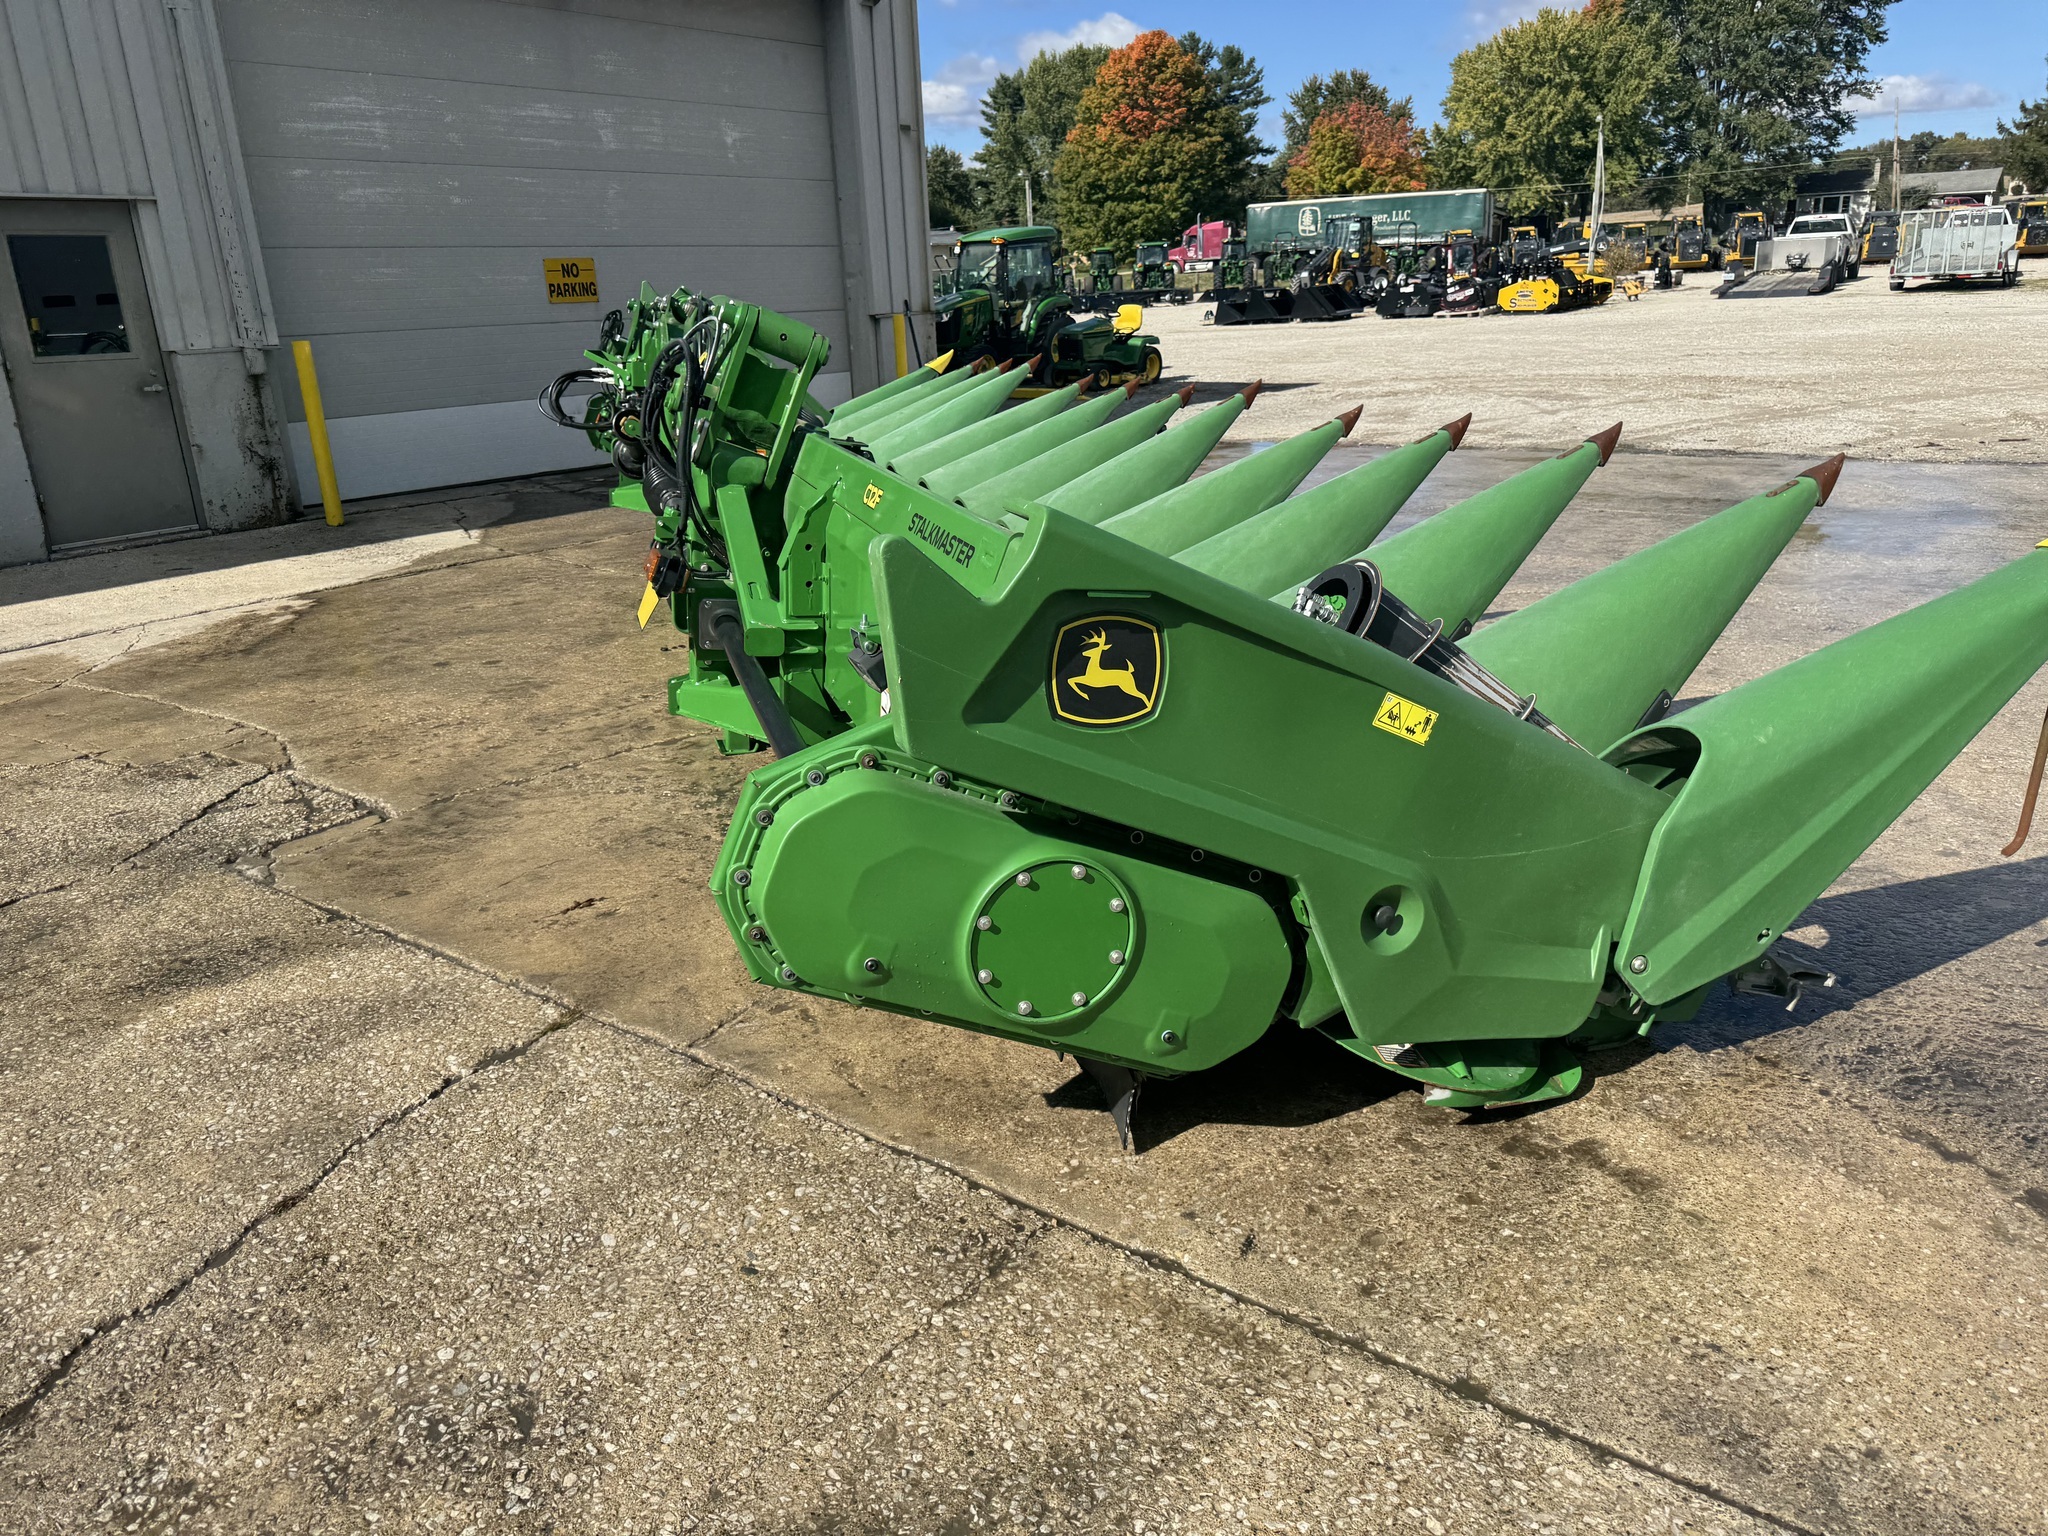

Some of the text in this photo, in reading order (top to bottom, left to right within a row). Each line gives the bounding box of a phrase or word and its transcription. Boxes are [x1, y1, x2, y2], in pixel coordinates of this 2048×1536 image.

[1371, 209, 1411, 226] ger, LLC
[561, 262, 579, 278] NO
[549, 282, 598, 298] PARKING
[862, 483, 884, 510] C12F
[908, 512, 976, 568] STALKMASTER
